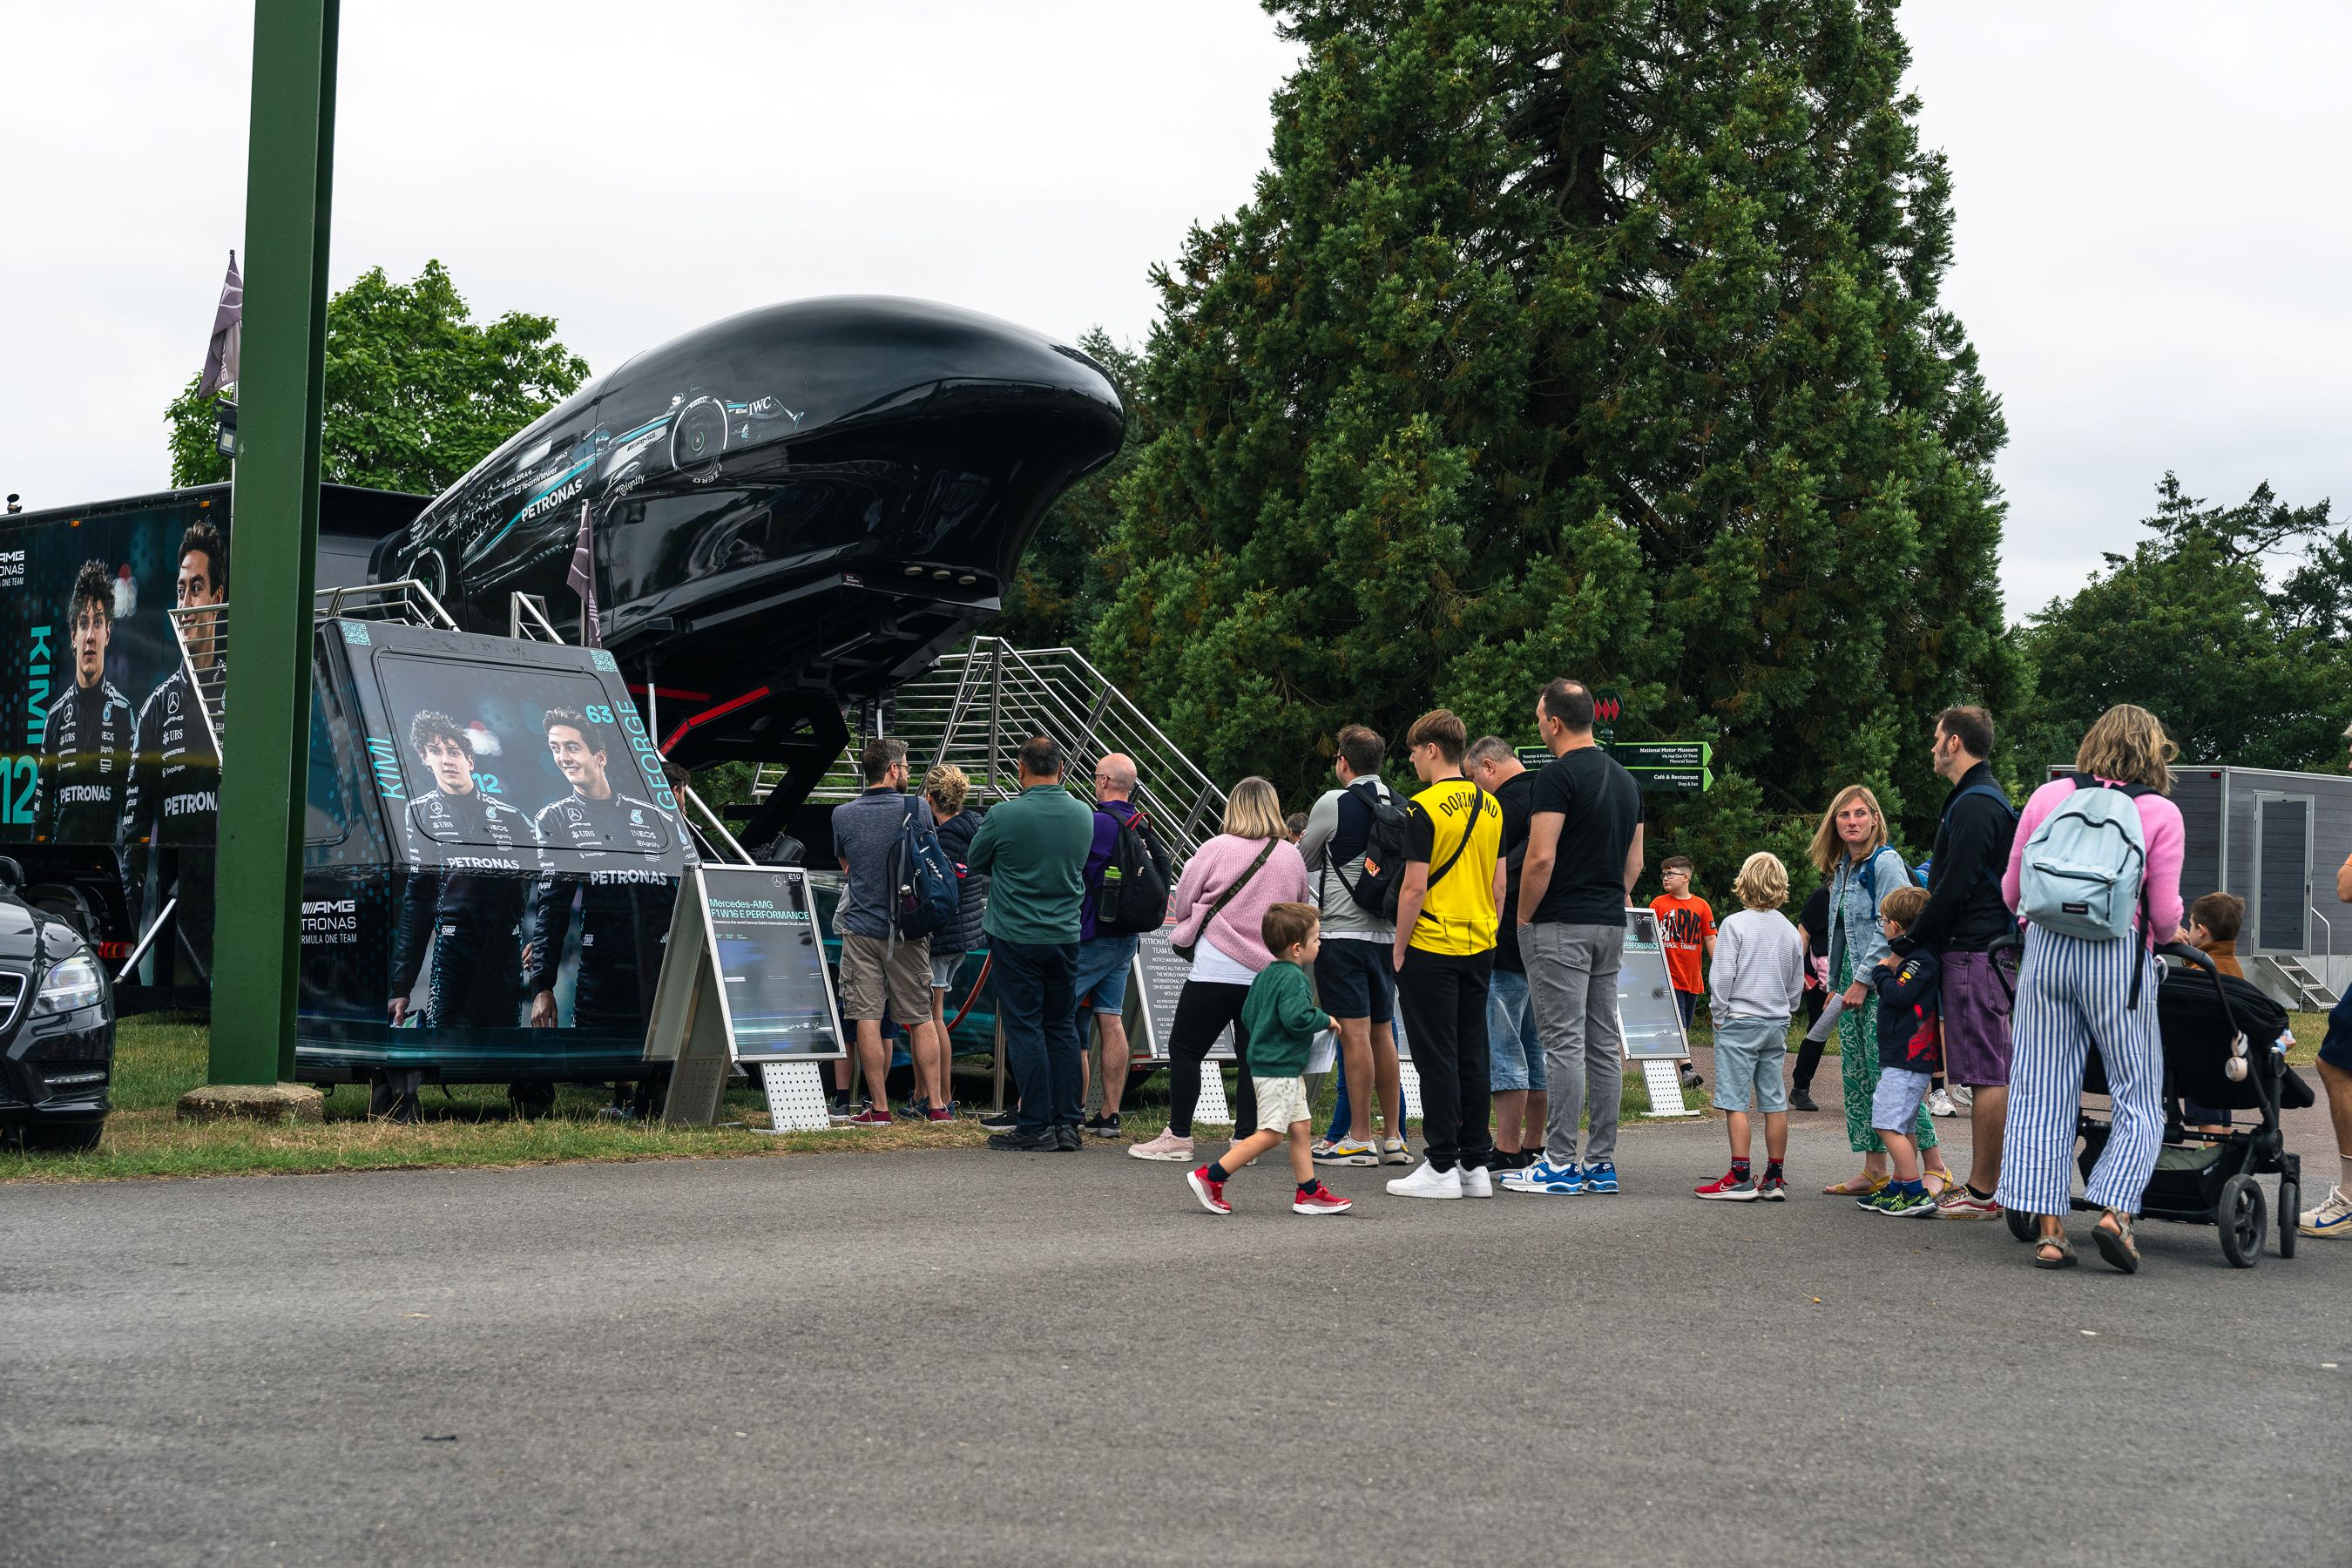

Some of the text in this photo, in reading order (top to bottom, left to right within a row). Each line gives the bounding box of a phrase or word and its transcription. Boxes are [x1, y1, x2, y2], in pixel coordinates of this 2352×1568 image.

[749, 396, 772, 416] IWC
[506, 471, 529, 487] SOLERA
[522, 466, 558, 490] TeamViewer
[521, 478, 583, 522] PETRONAS
[12, 577, 24, 586] TEAM
[27, 625, 51, 745] KIMI
[585, 705, 614, 724] 63
[64, 733, 76, 743] UBS
[170, 729, 183, 741] UBS
[616, 700, 679, 810] GEORGE
[367, 737, 406, 800] KIMI
[0, 754, 38, 824] 12
[471, 773, 503, 794] 12
[60, 785, 112, 803] PETRONAS
[1439, 792, 1498, 818] DORTMND
[631, 829, 657, 839] INEOS
[446, 856, 520, 869] PETRONAS
[591, 869, 668, 886] PETRONAS
[307, 900, 355, 914] AMG
[709, 898, 774, 909] Mercedes-AMG
[711, 909, 720, 917] F1
[720, 909, 739, 918] W16
[746, 910, 810, 920] PERFORMANCE
[325, 934, 338, 943] ONE
[340, 933, 358, 943] TEAM
